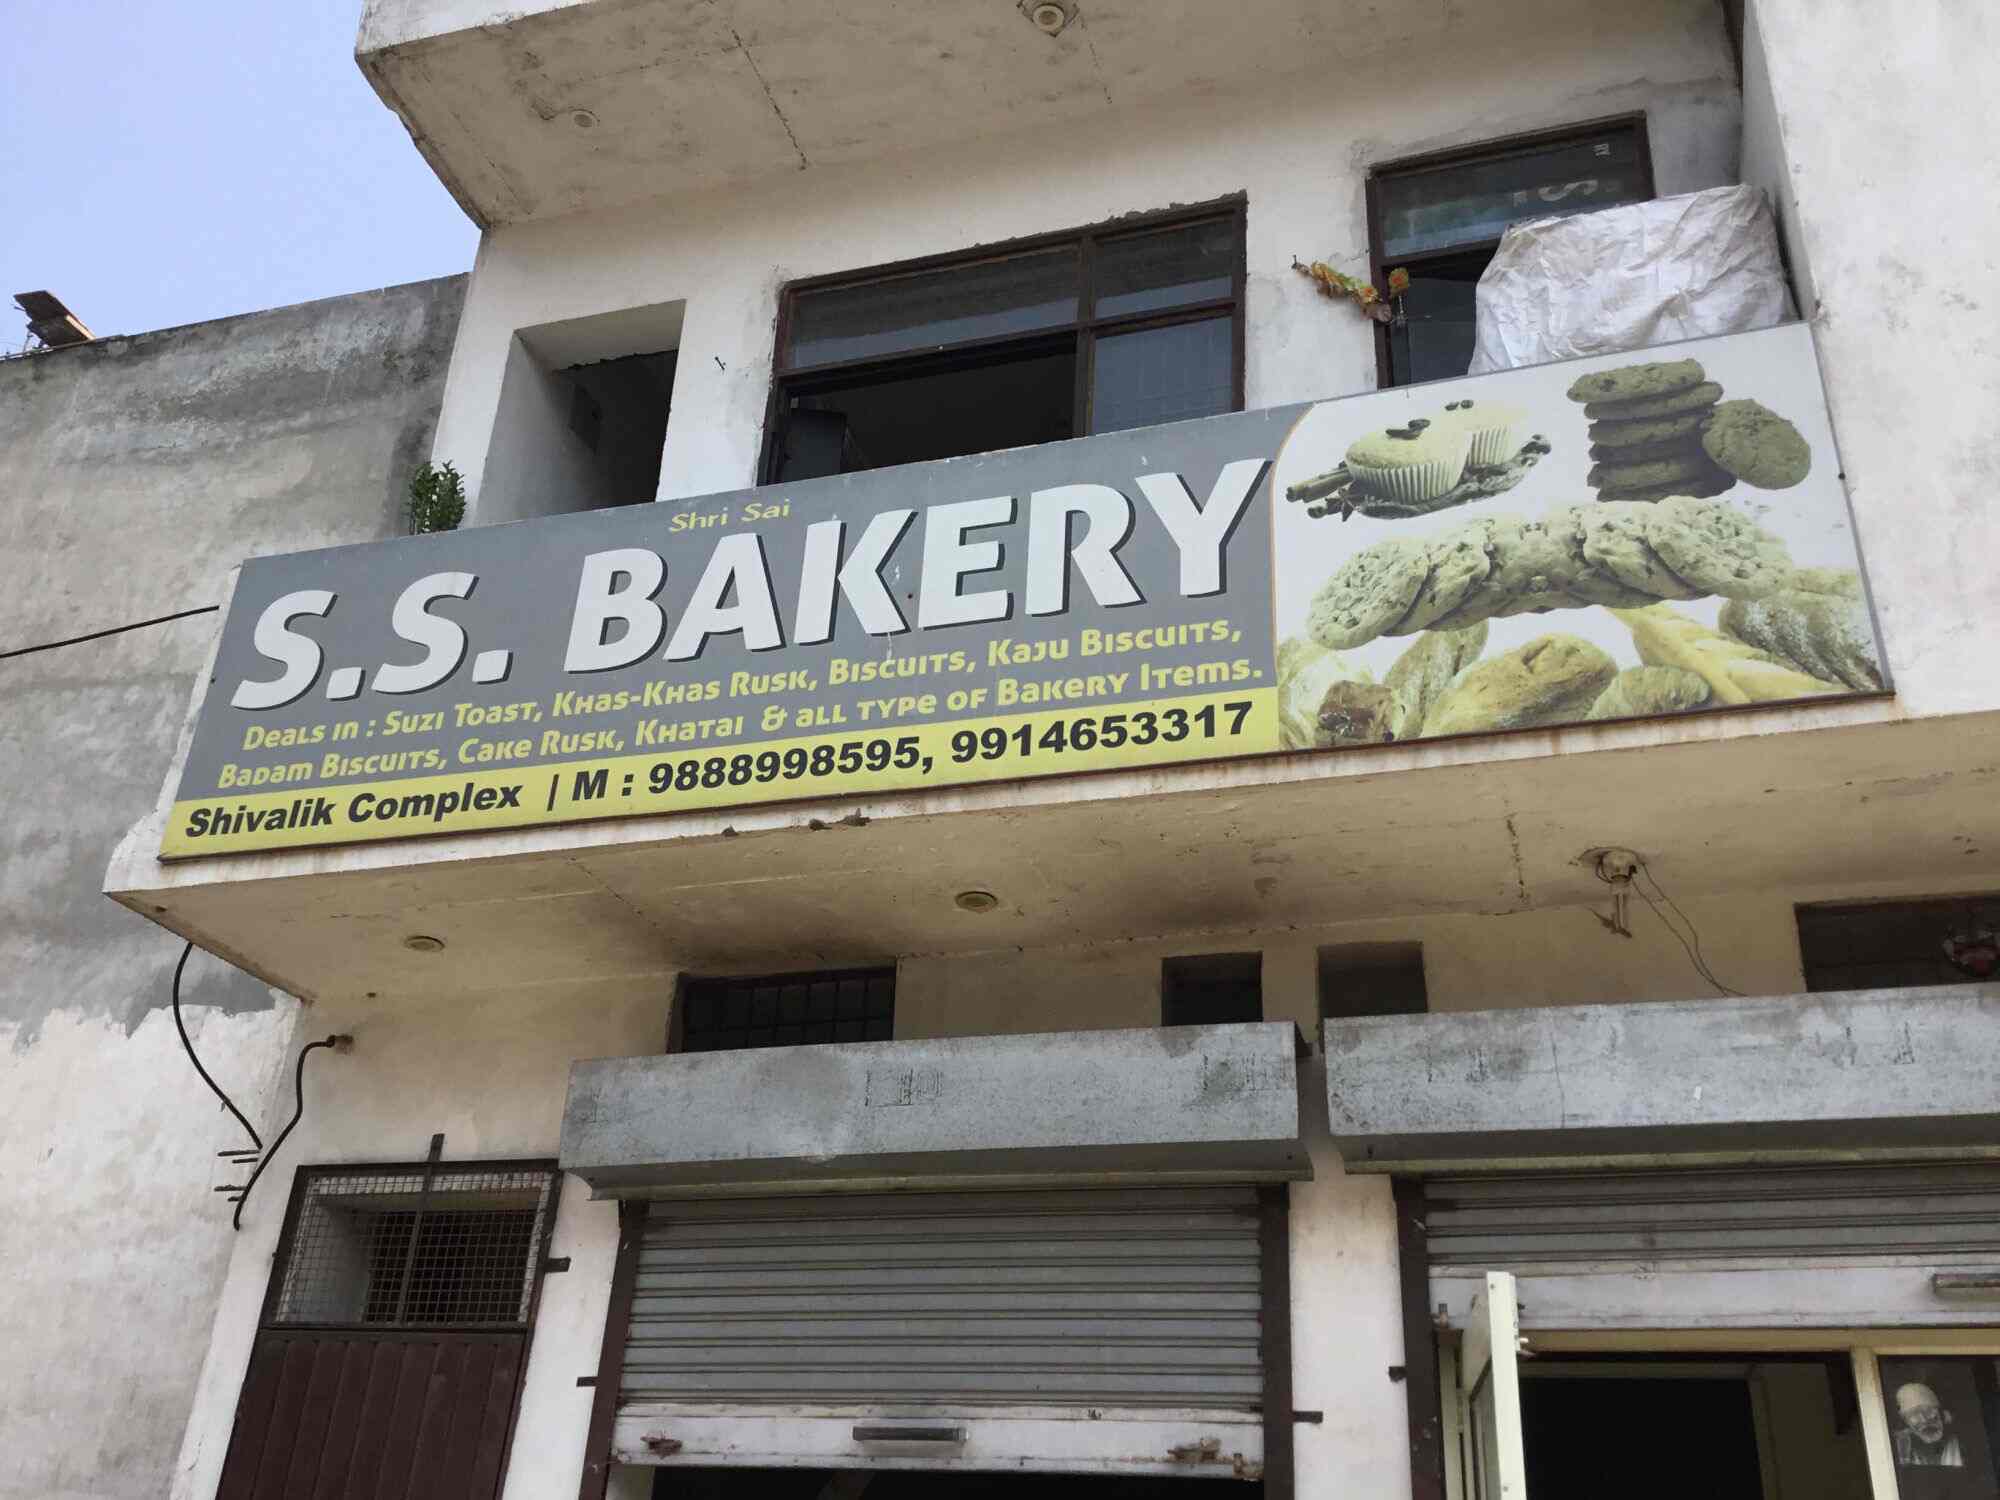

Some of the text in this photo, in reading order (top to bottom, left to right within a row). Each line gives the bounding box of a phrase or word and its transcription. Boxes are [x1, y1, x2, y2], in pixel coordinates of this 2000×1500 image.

[669, 499, 792, 533] Shri Sai
[231, 457, 1272, 710] S.S. BAKERY
[763, 704, 787, 732] &
[186, 798, 336, 837] Shivalik
[349, 783, 522, 822] Complex
[649, 737, 932, 793] 9888998595,
[952, 701, 1252, 762] 9914653317
